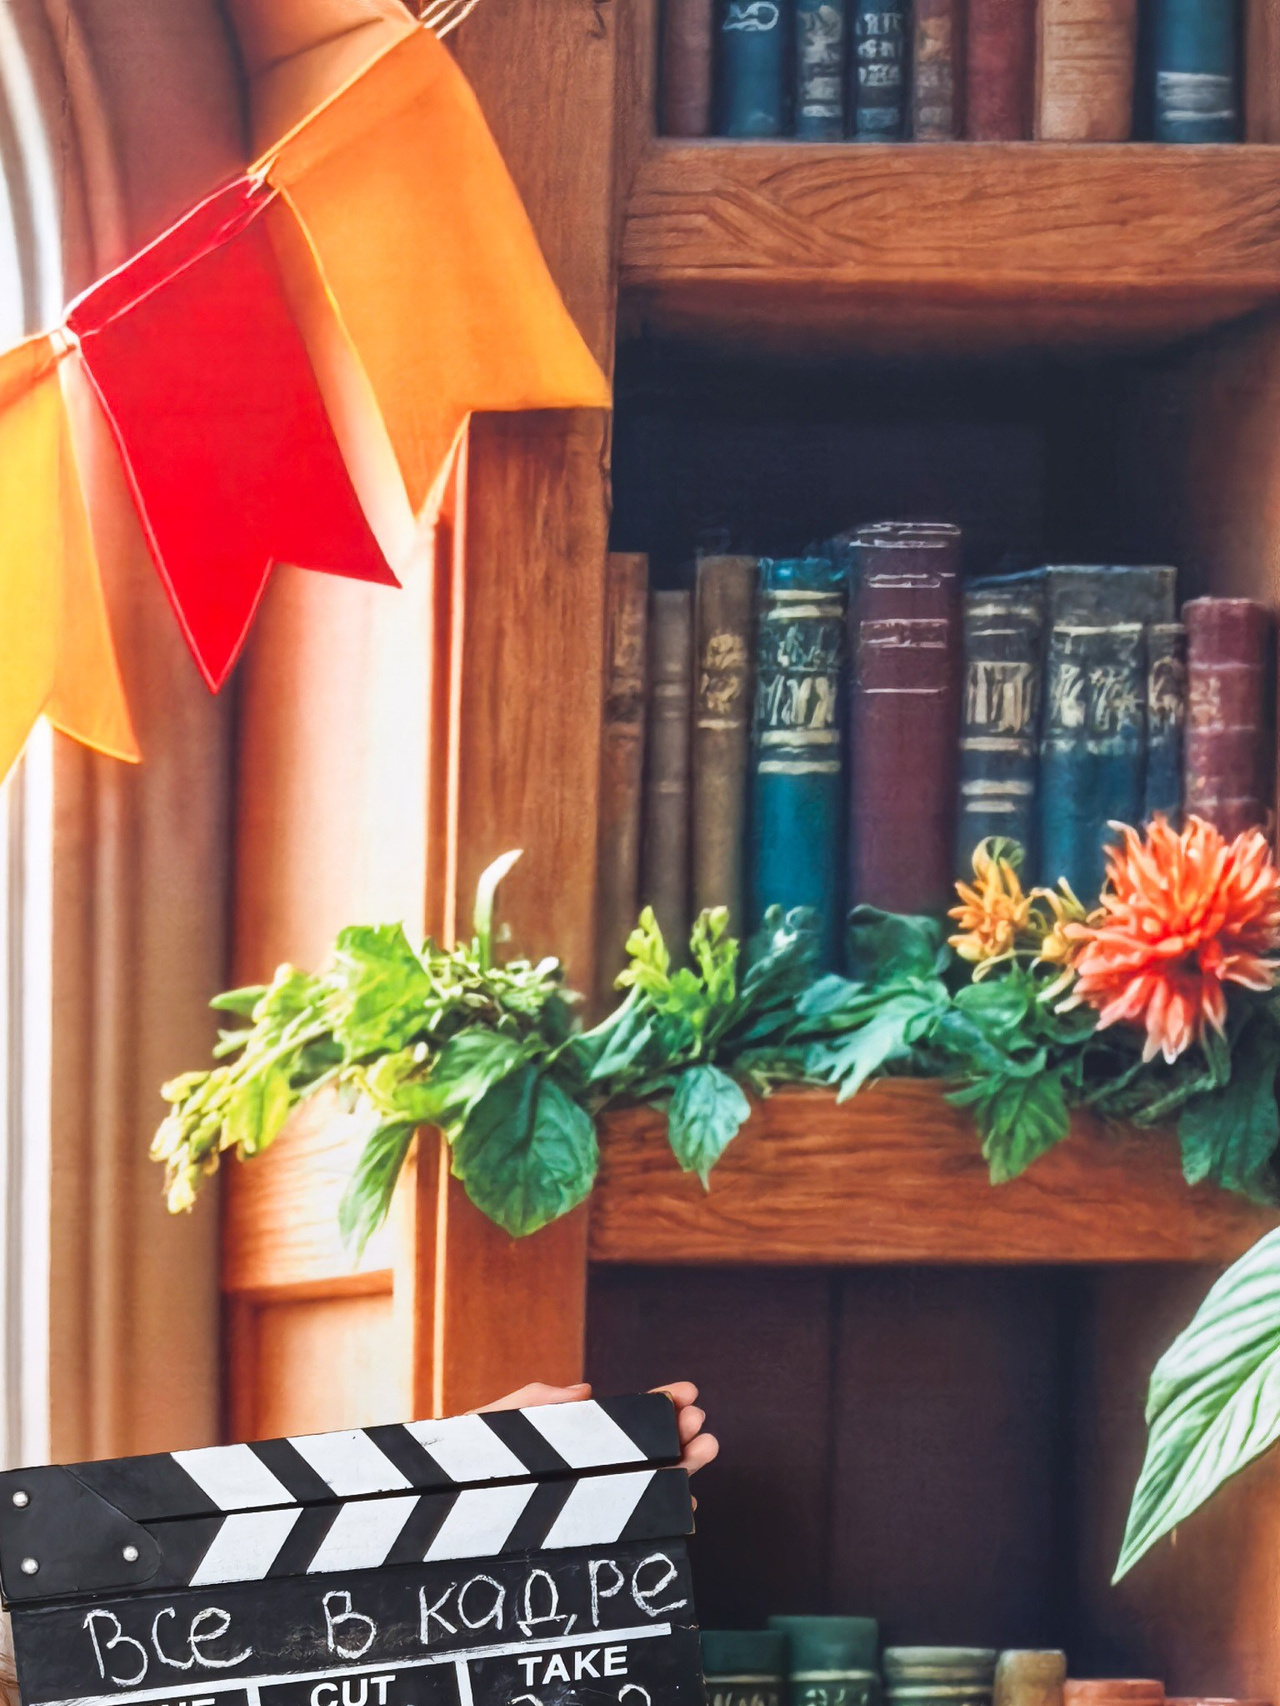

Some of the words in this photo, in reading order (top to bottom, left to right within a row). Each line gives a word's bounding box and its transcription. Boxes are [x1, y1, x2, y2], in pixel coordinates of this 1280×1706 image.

[82, 1606, 253, 1687] Все
[418, 1552, 688, 1645] кадре
[517, 1645, 629, 1688] TAKE
